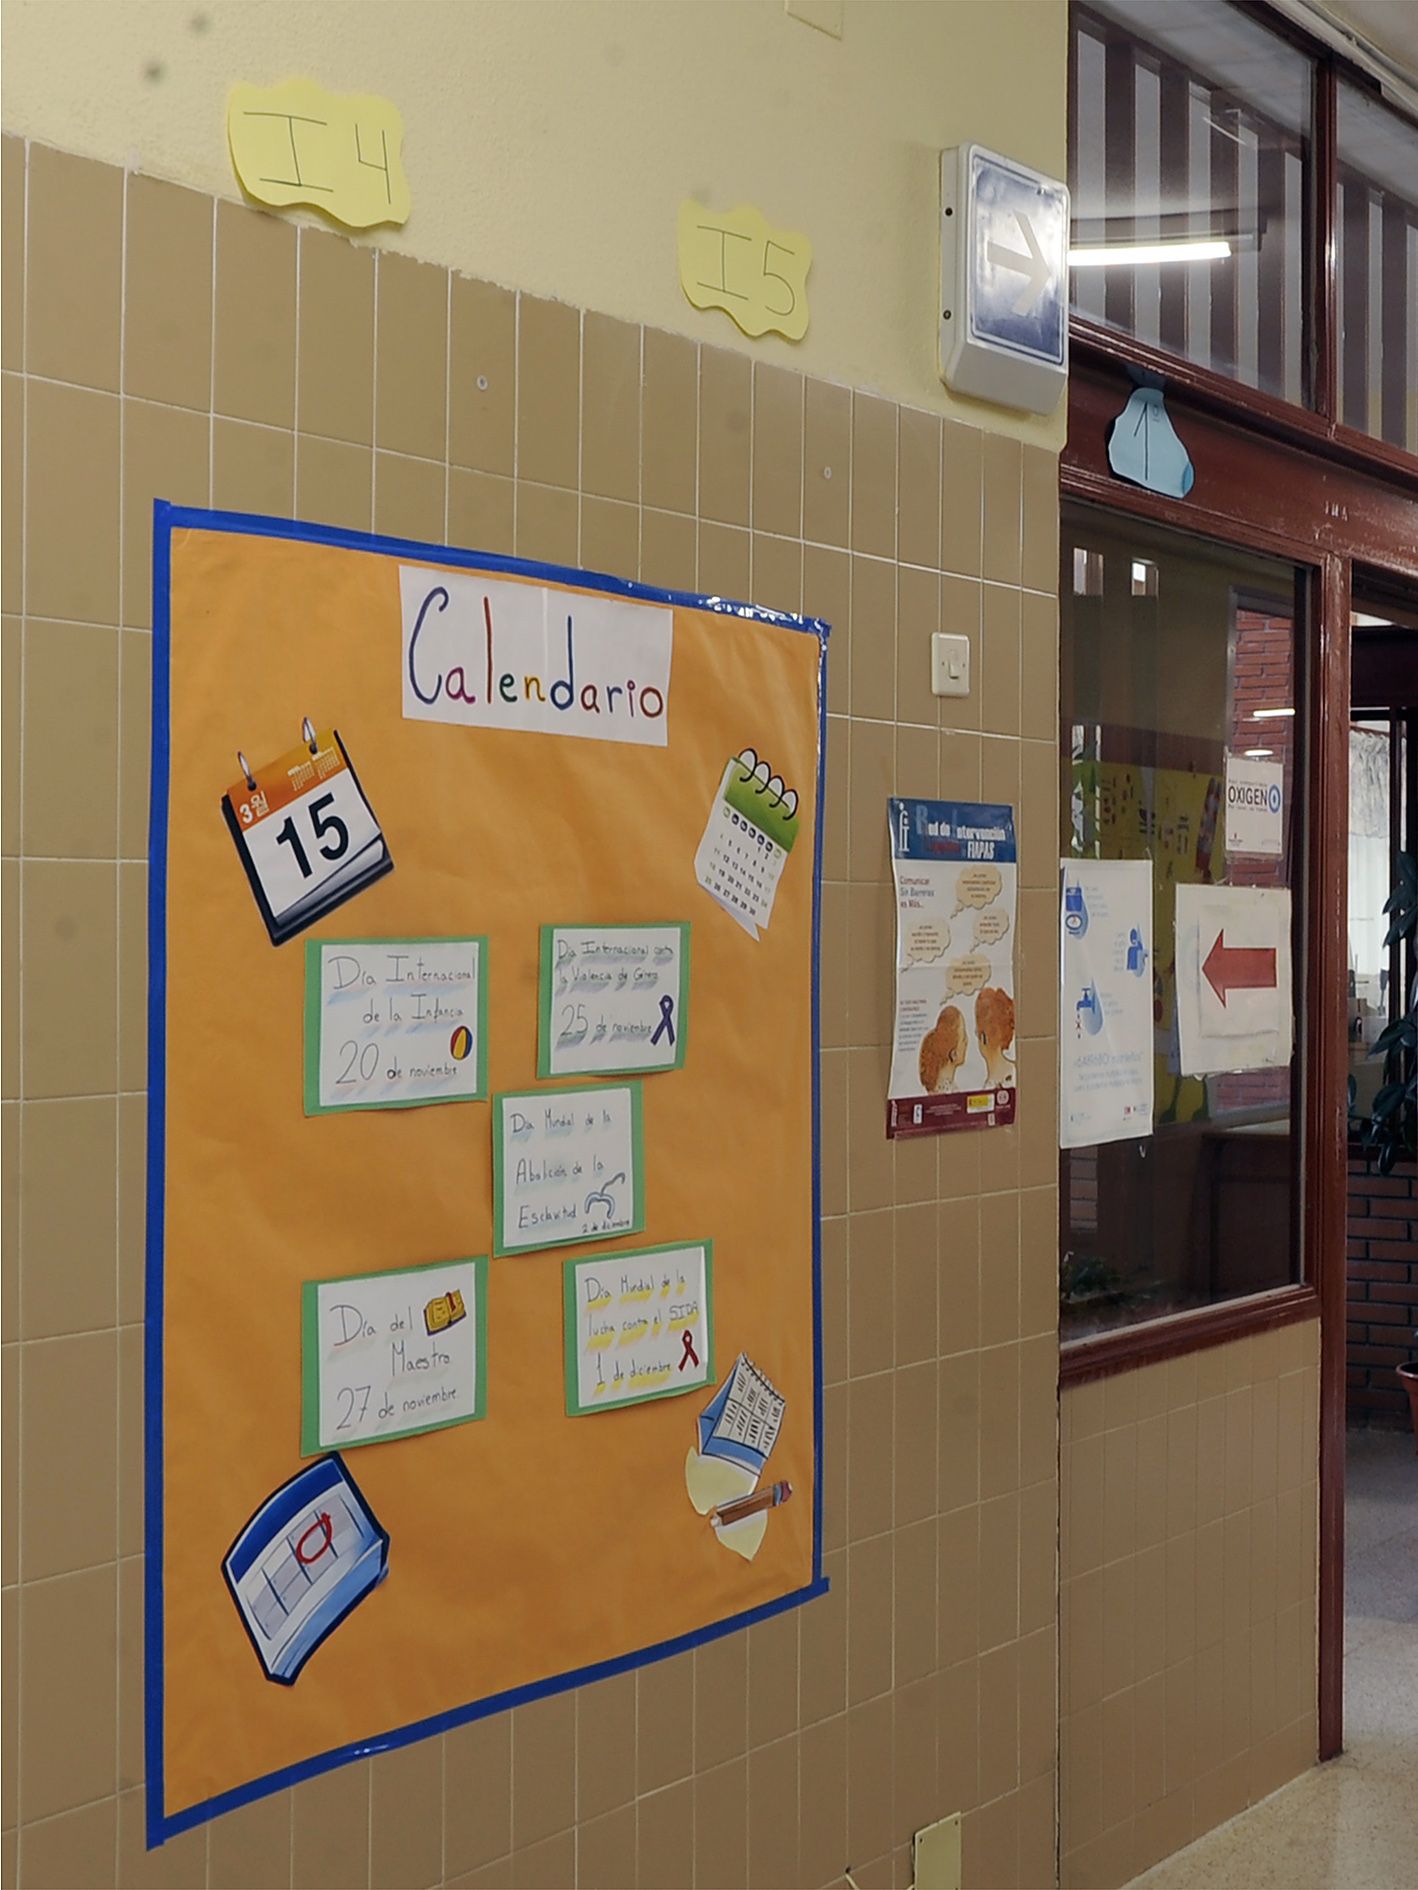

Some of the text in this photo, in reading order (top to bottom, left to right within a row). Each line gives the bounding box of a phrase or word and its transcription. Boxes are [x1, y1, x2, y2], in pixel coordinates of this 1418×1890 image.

[408, 585, 664, 719] Calendario
[275, 791, 350, 879] 15
[967, 841, 995, 860] FIAPAS
[581, 940, 649, 956] Internacional
[328, 954, 476, 990] Día Internacional
[571, 965, 612, 982] Violencia
[618, 967, 628, 981] de
[363, 993, 464, 1024] de la Infancia
[560, 1004, 652, 1037] 25 de noviembre
[335, 1040, 458, 1085] 20 de noviembre
[585, 1113, 594, 1125] de
[603, 1109, 611, 1123] la
[572, 1161, 582, 1175] de
[593, 1154, 605, 1172] la
[518, 1203, 577, 1229] Esclavitud
[584, 1269, 686, 1303] Día Mundial de la
[329, 1304, 413, 1347] Día del
[588, 1313, 615, 1337] lucha
[653, 1308, 662, 1324] el
[669, 1301, 698, 1322] SIDA
[391, 1339, 450, 1377] Maestro
[596, 1352, 671, 1386] 1 de diciembre
[336, 1385, 457, 1431] 27 de noviembre
